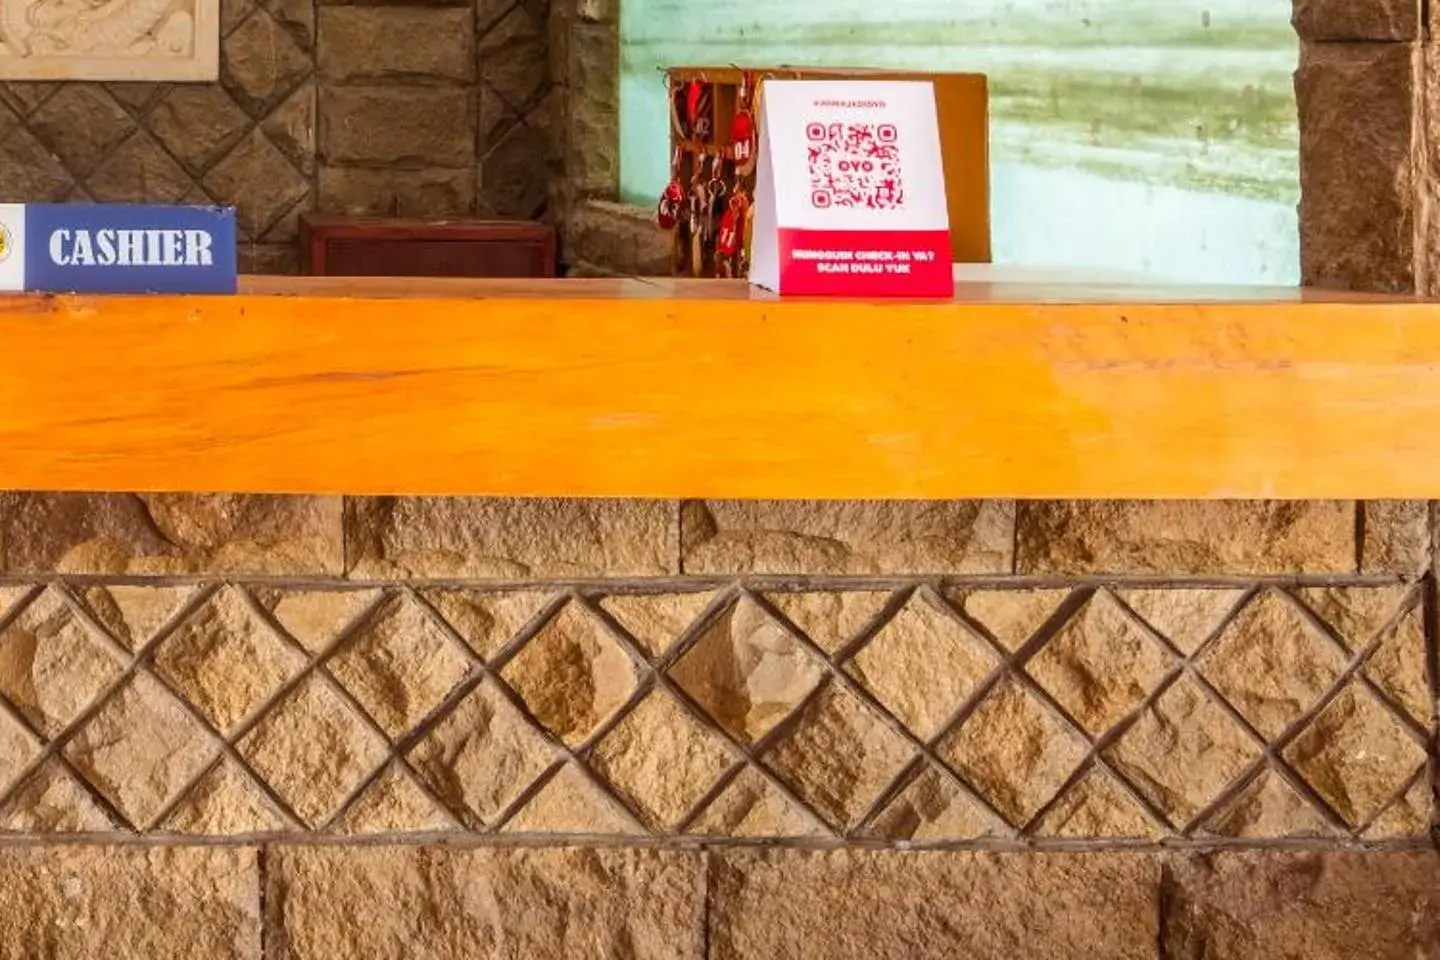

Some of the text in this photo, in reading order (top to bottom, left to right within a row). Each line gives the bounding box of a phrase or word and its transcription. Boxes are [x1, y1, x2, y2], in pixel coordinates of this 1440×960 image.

[734, 140, 750, 161] 04
[838, 160, 874, 172] OYO
[48, 228, 214, 266] CASHIER
[855, 249, 910, 261] CHECK-IN
[817, 262, 910, 274] SCAN DULU YUK
